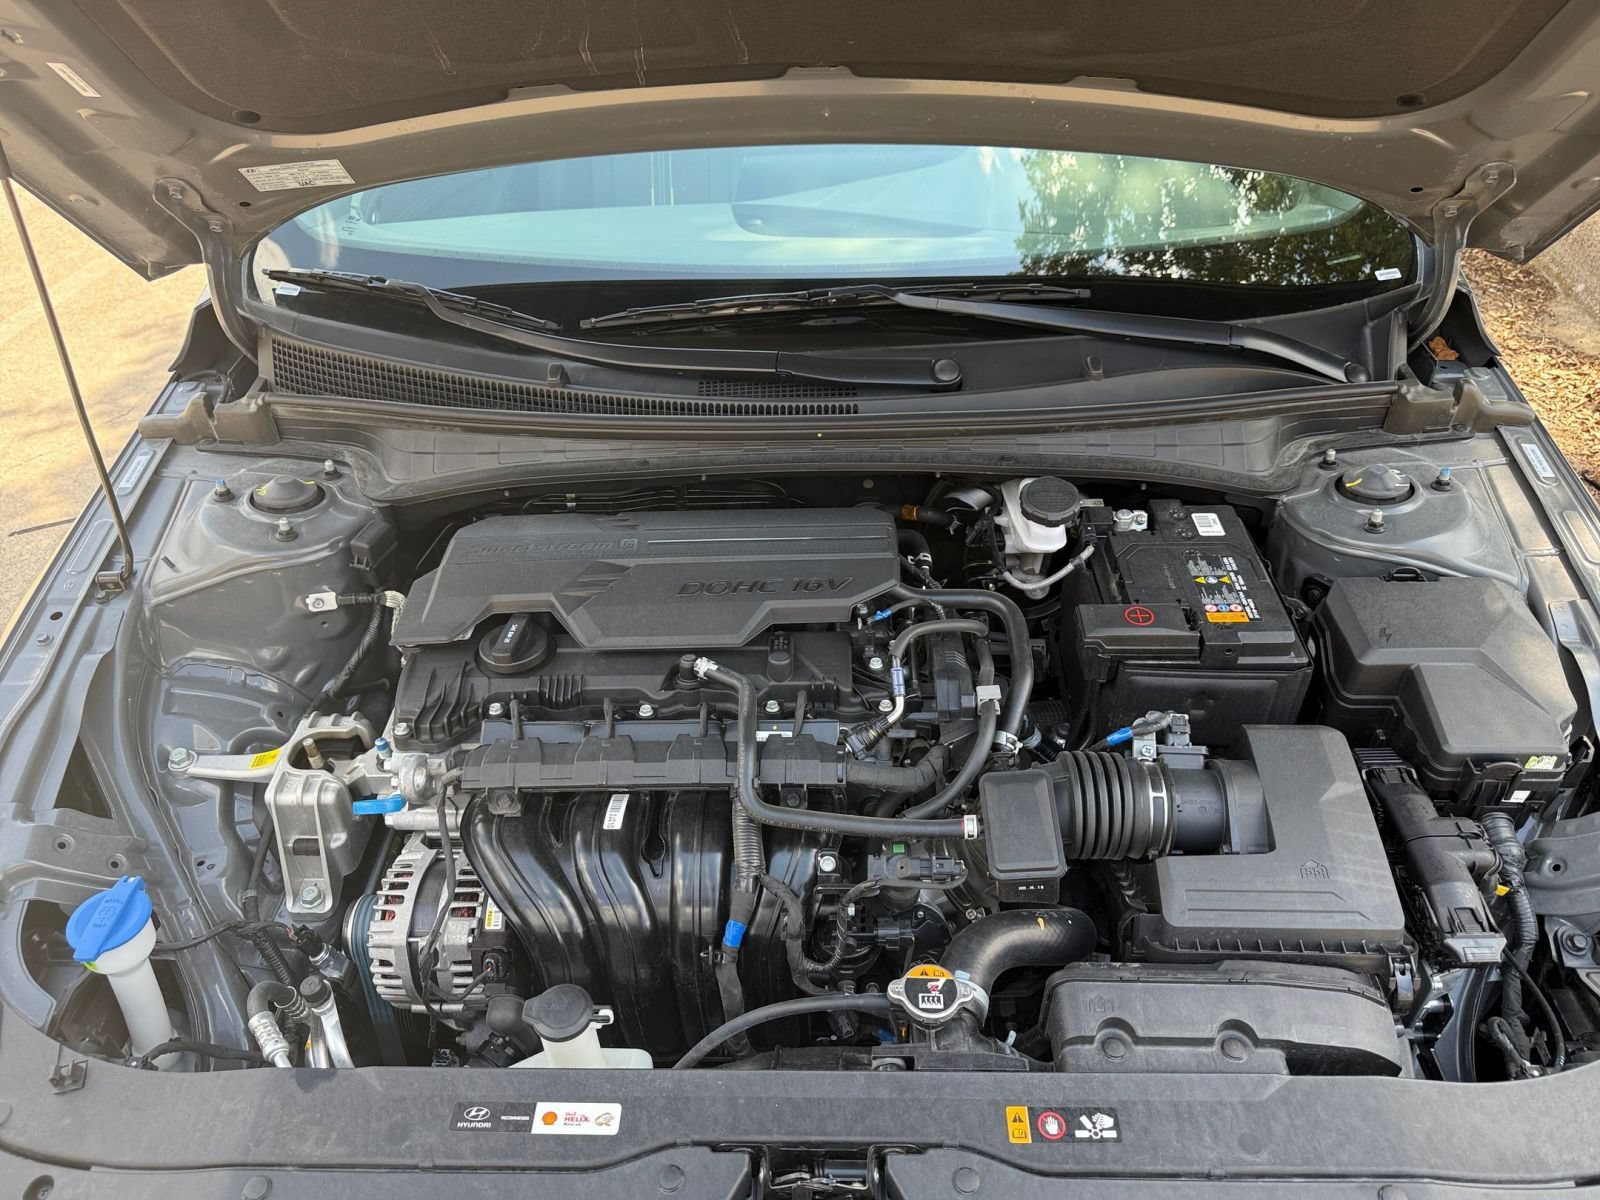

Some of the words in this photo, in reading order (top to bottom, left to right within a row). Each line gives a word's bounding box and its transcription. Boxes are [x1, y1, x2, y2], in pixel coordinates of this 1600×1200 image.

[676, 578, 784, 597] DOHC
[791, 576, 855, 593] 16V
[564, 1114, 590, 1122] HELIX
[457, 1121, 492, 1129] HYUNDAI
